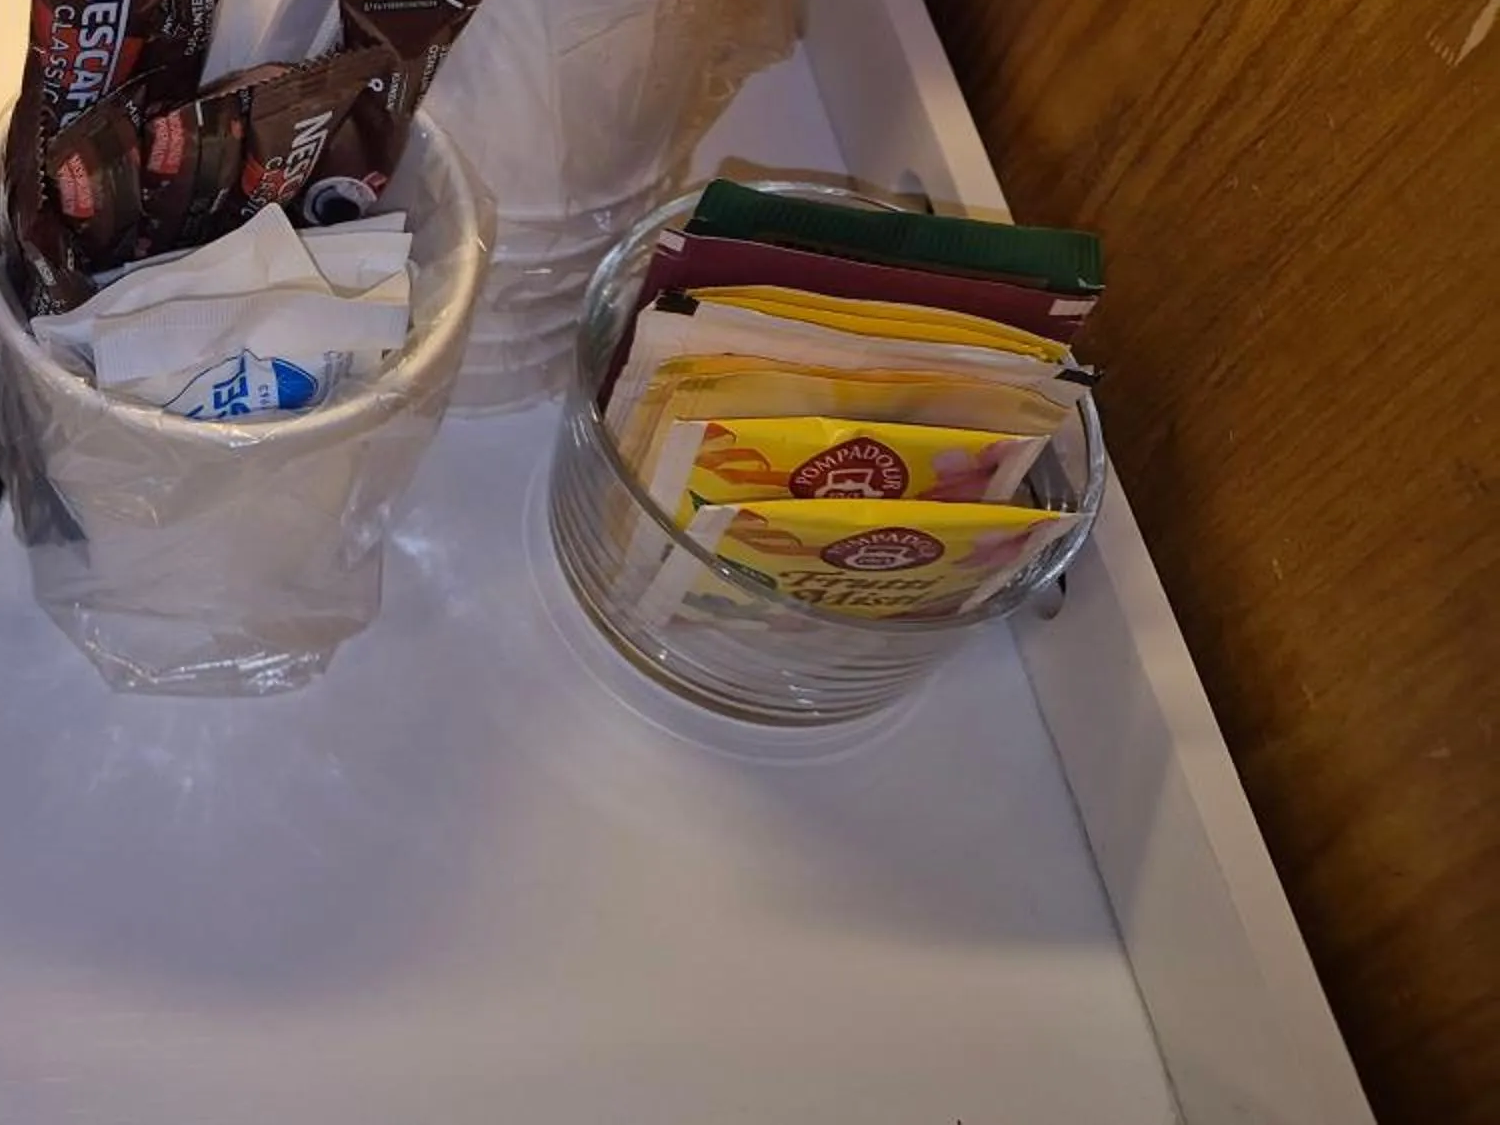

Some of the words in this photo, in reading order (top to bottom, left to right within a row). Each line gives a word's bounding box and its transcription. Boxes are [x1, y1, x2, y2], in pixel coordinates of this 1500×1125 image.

[44, 5, 76, 104] CLASSIC
[278, 110, 333, 197] NESC
[795, 444, 901, 491] POMPADOUR
